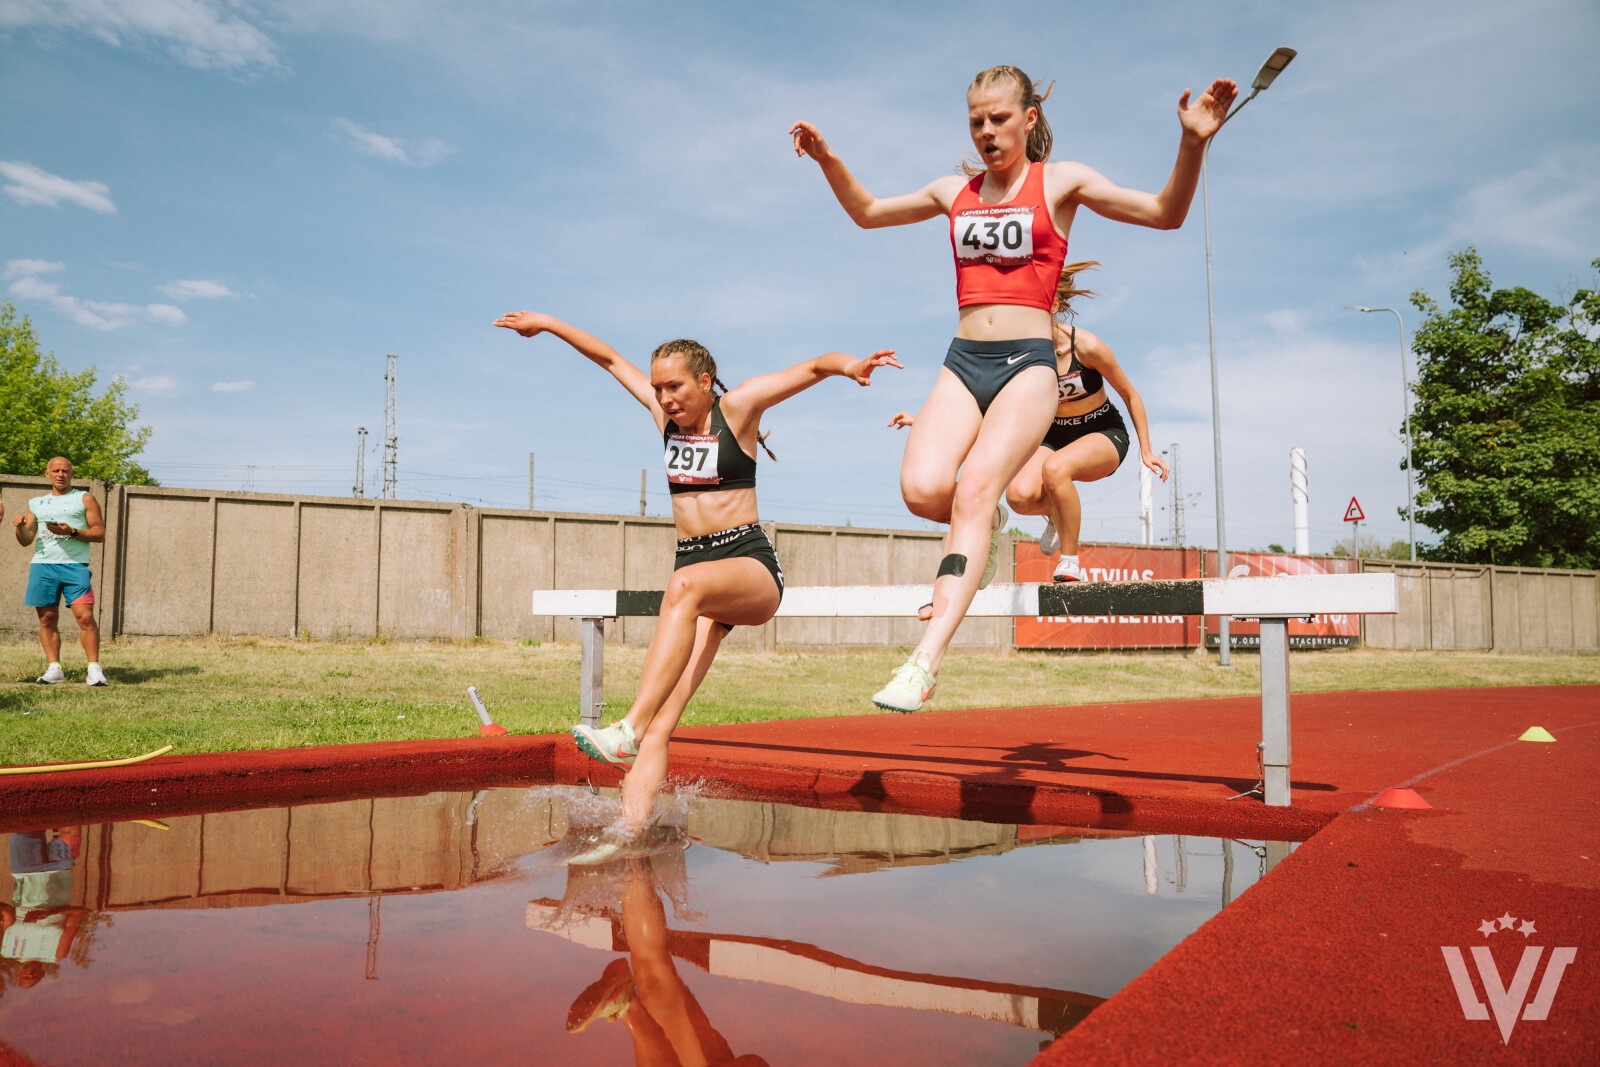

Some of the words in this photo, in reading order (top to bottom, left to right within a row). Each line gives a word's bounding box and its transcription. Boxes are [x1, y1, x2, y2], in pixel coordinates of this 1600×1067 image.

[962, 220, 1022, 250] 430
[1053, 416, 1081, 426] NIKE
[1084, 404, 1110, 423] PRO
[668, 445, 709, 472] 297
[1079, 567, 1154, 582] ATVIJAS
